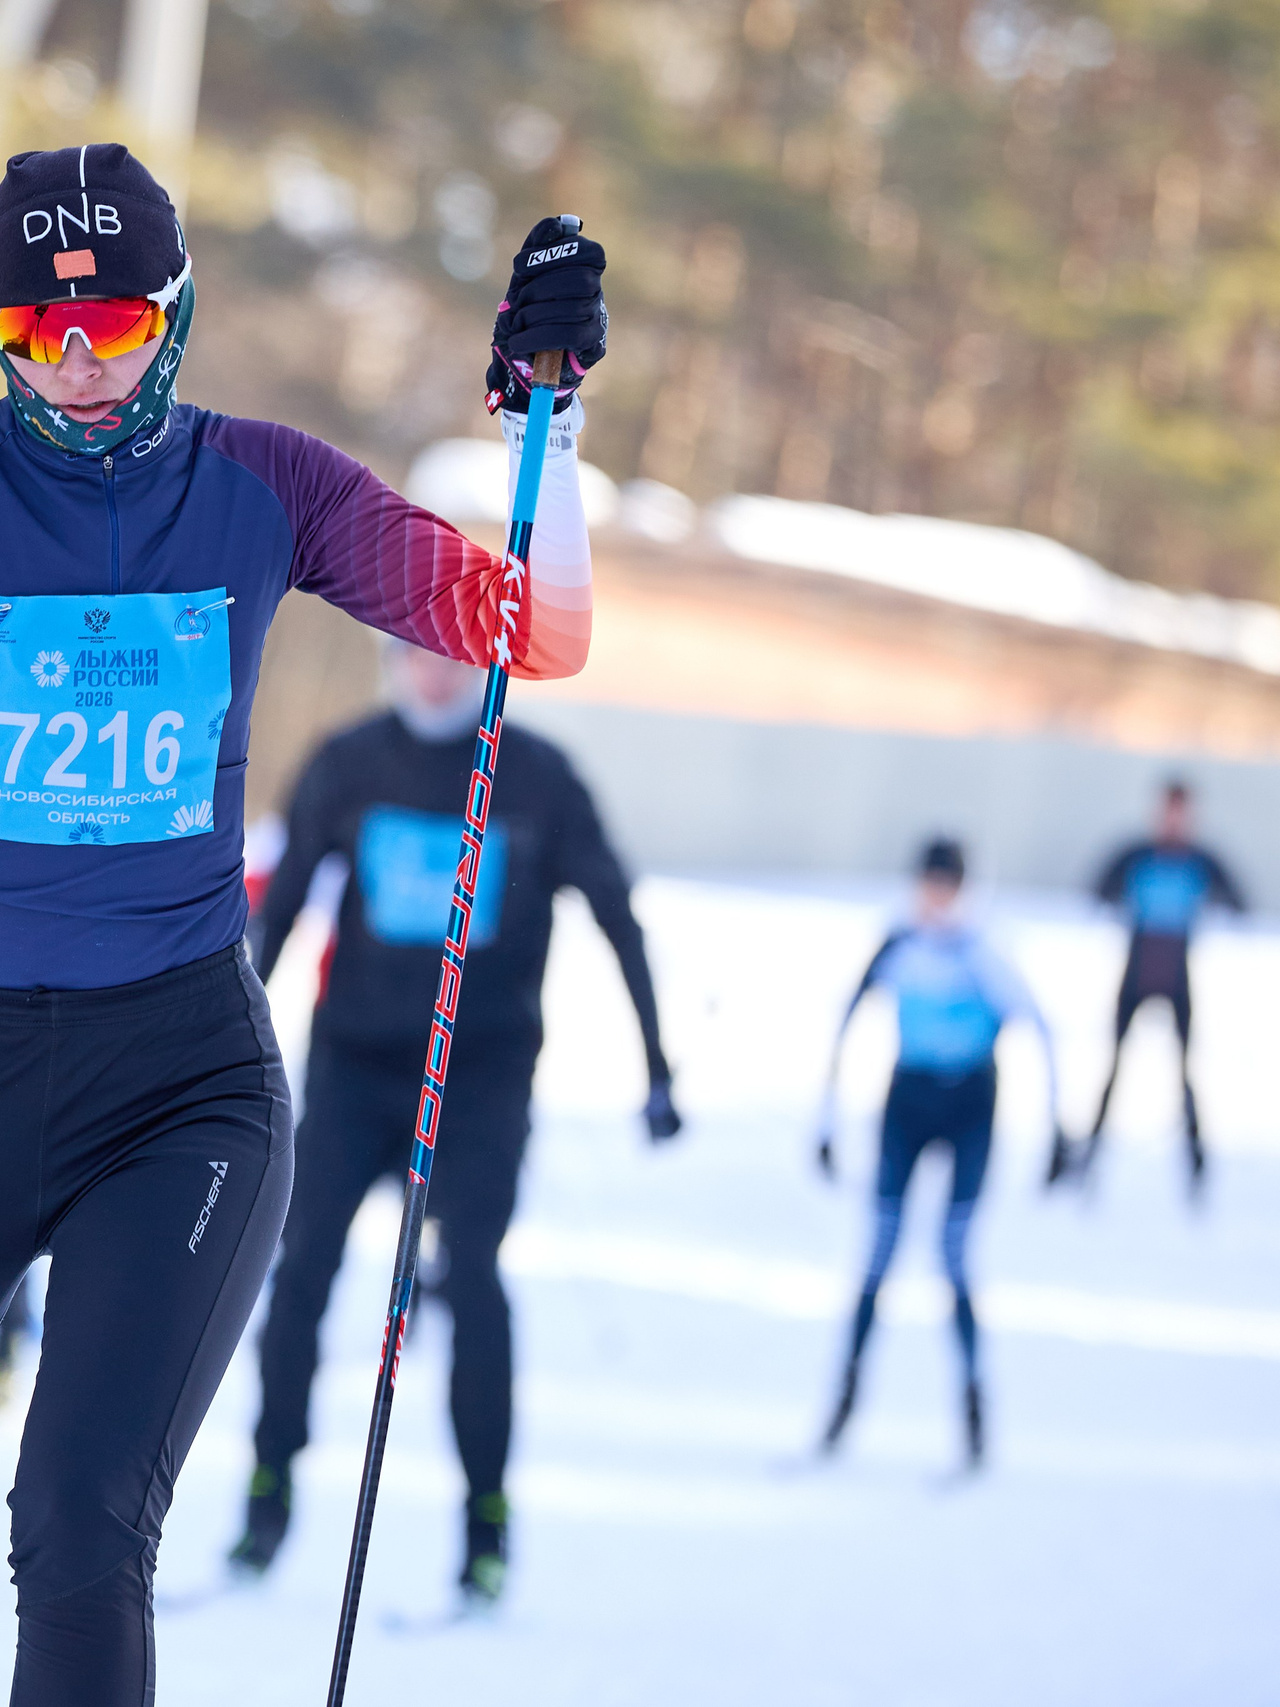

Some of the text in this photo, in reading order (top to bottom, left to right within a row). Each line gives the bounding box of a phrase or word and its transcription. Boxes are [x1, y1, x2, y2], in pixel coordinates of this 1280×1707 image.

[23, 192, 122, 249] DNB
[527, 242, 579, 267] KV+
[493, 551, 526, 667] KV+
[74, 648, 159, 668] ЛЫЖНЯ
[73, 669, 159, 687] РОССИИ
[75, 691, 114, 707] 2026
[47, 811, 131, 826] ОБЛАСТЬ
[414, 714, 503, 1151] TORNADO
[187, 1175, 223, 1254] FISCHER
